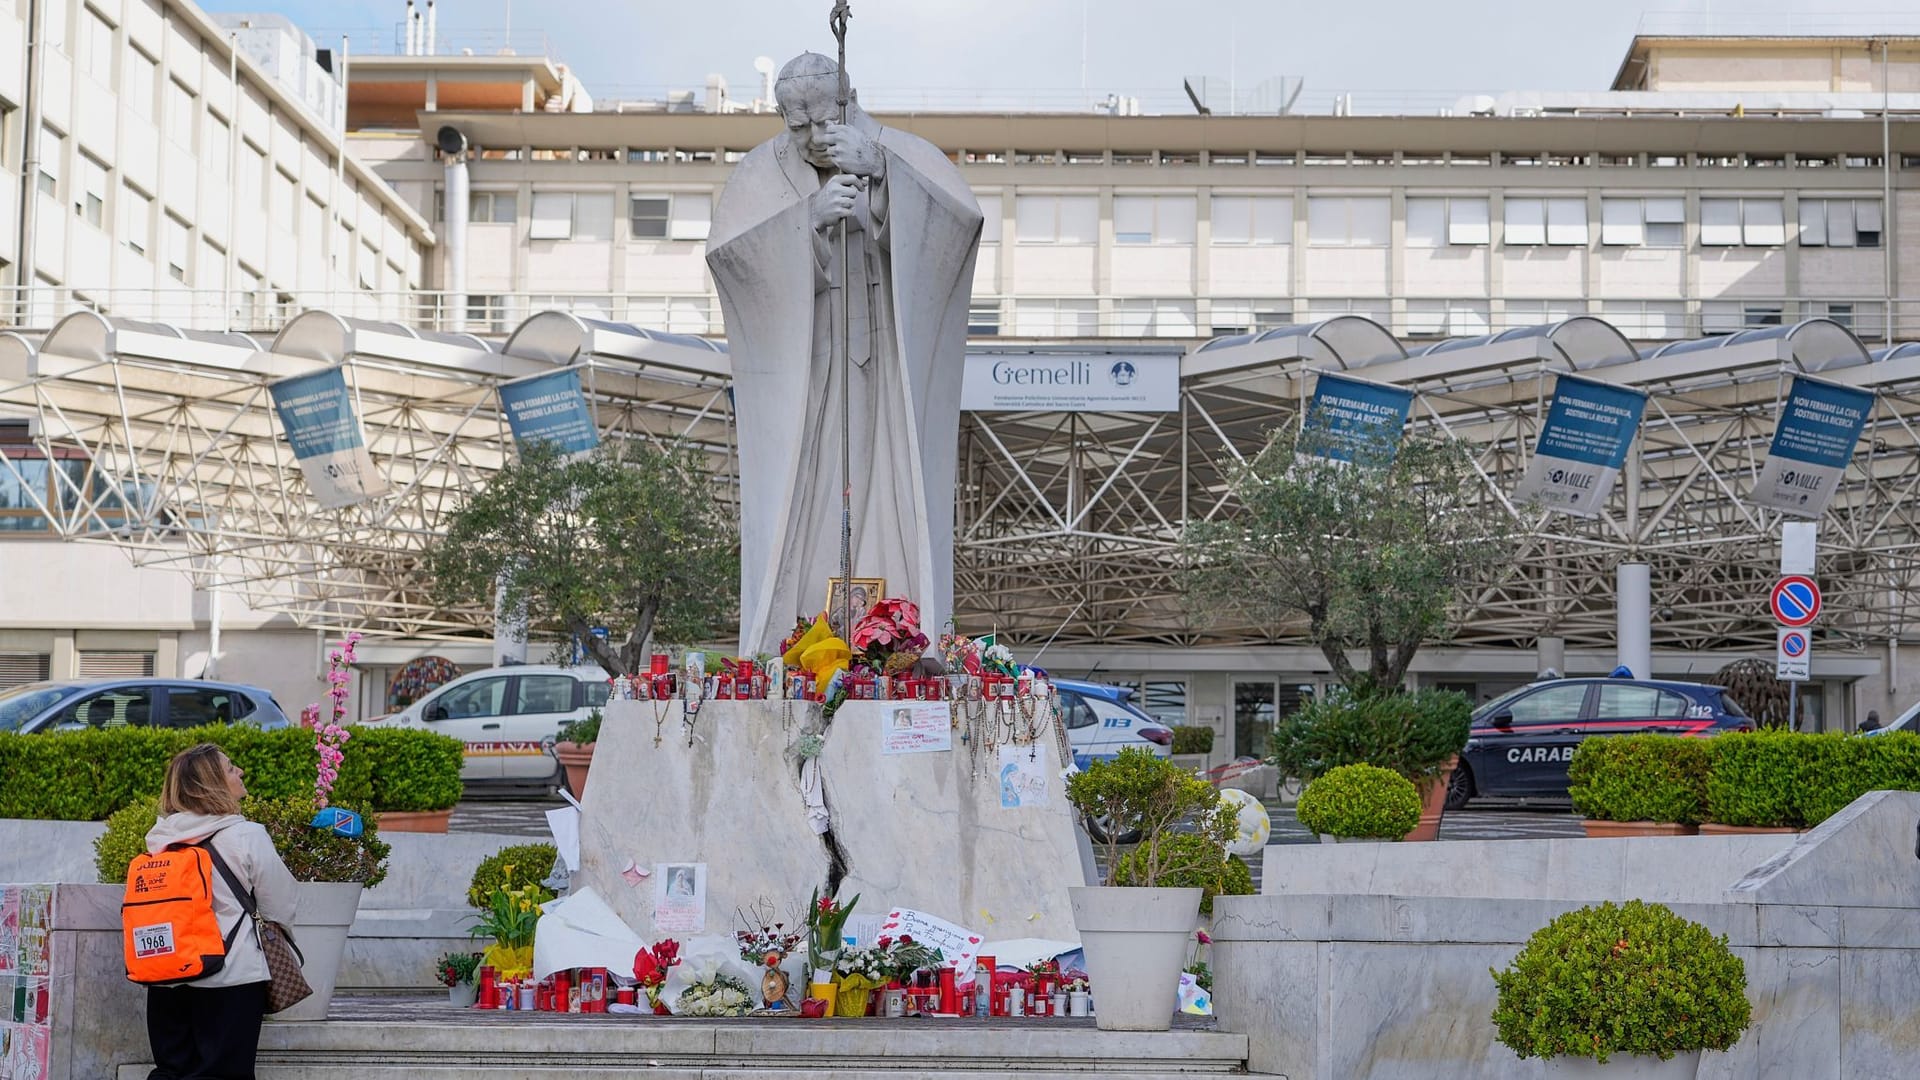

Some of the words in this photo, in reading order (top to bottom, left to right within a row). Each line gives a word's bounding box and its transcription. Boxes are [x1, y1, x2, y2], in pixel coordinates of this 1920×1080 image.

[993, 361, 1090, 385] Gemelli
[510, 402, 525, 411] NON
[544, 405, 552, 415] LA
[1320, 394, 1338, 405] NON
[1338, 398, 1370, 411] FERMARE
[1370, 403, 1380, 413] LA
[1558, 396, 1571, 405] NON
[1572, 399, 1595, 409] FERMARE
[1595, 403, 1603, 411] LA
[1793, 396, 1810, 407] NON
[1810, 401, 1836, 413] FERMARE
[1836, 406, 1845, 415] LA
[1564, 408, 1587, 419] SOSTIENI
[1794, 408, 1821, 421] SOSTIENI
[1821, 414, 1830, 422] LA
[1690, 704, 1712, 716] 112
[1103, 718, 1132, 728] 113
[1507, 746, 1577, 763] CARAB
[141, 935, 165, 950] 1968
